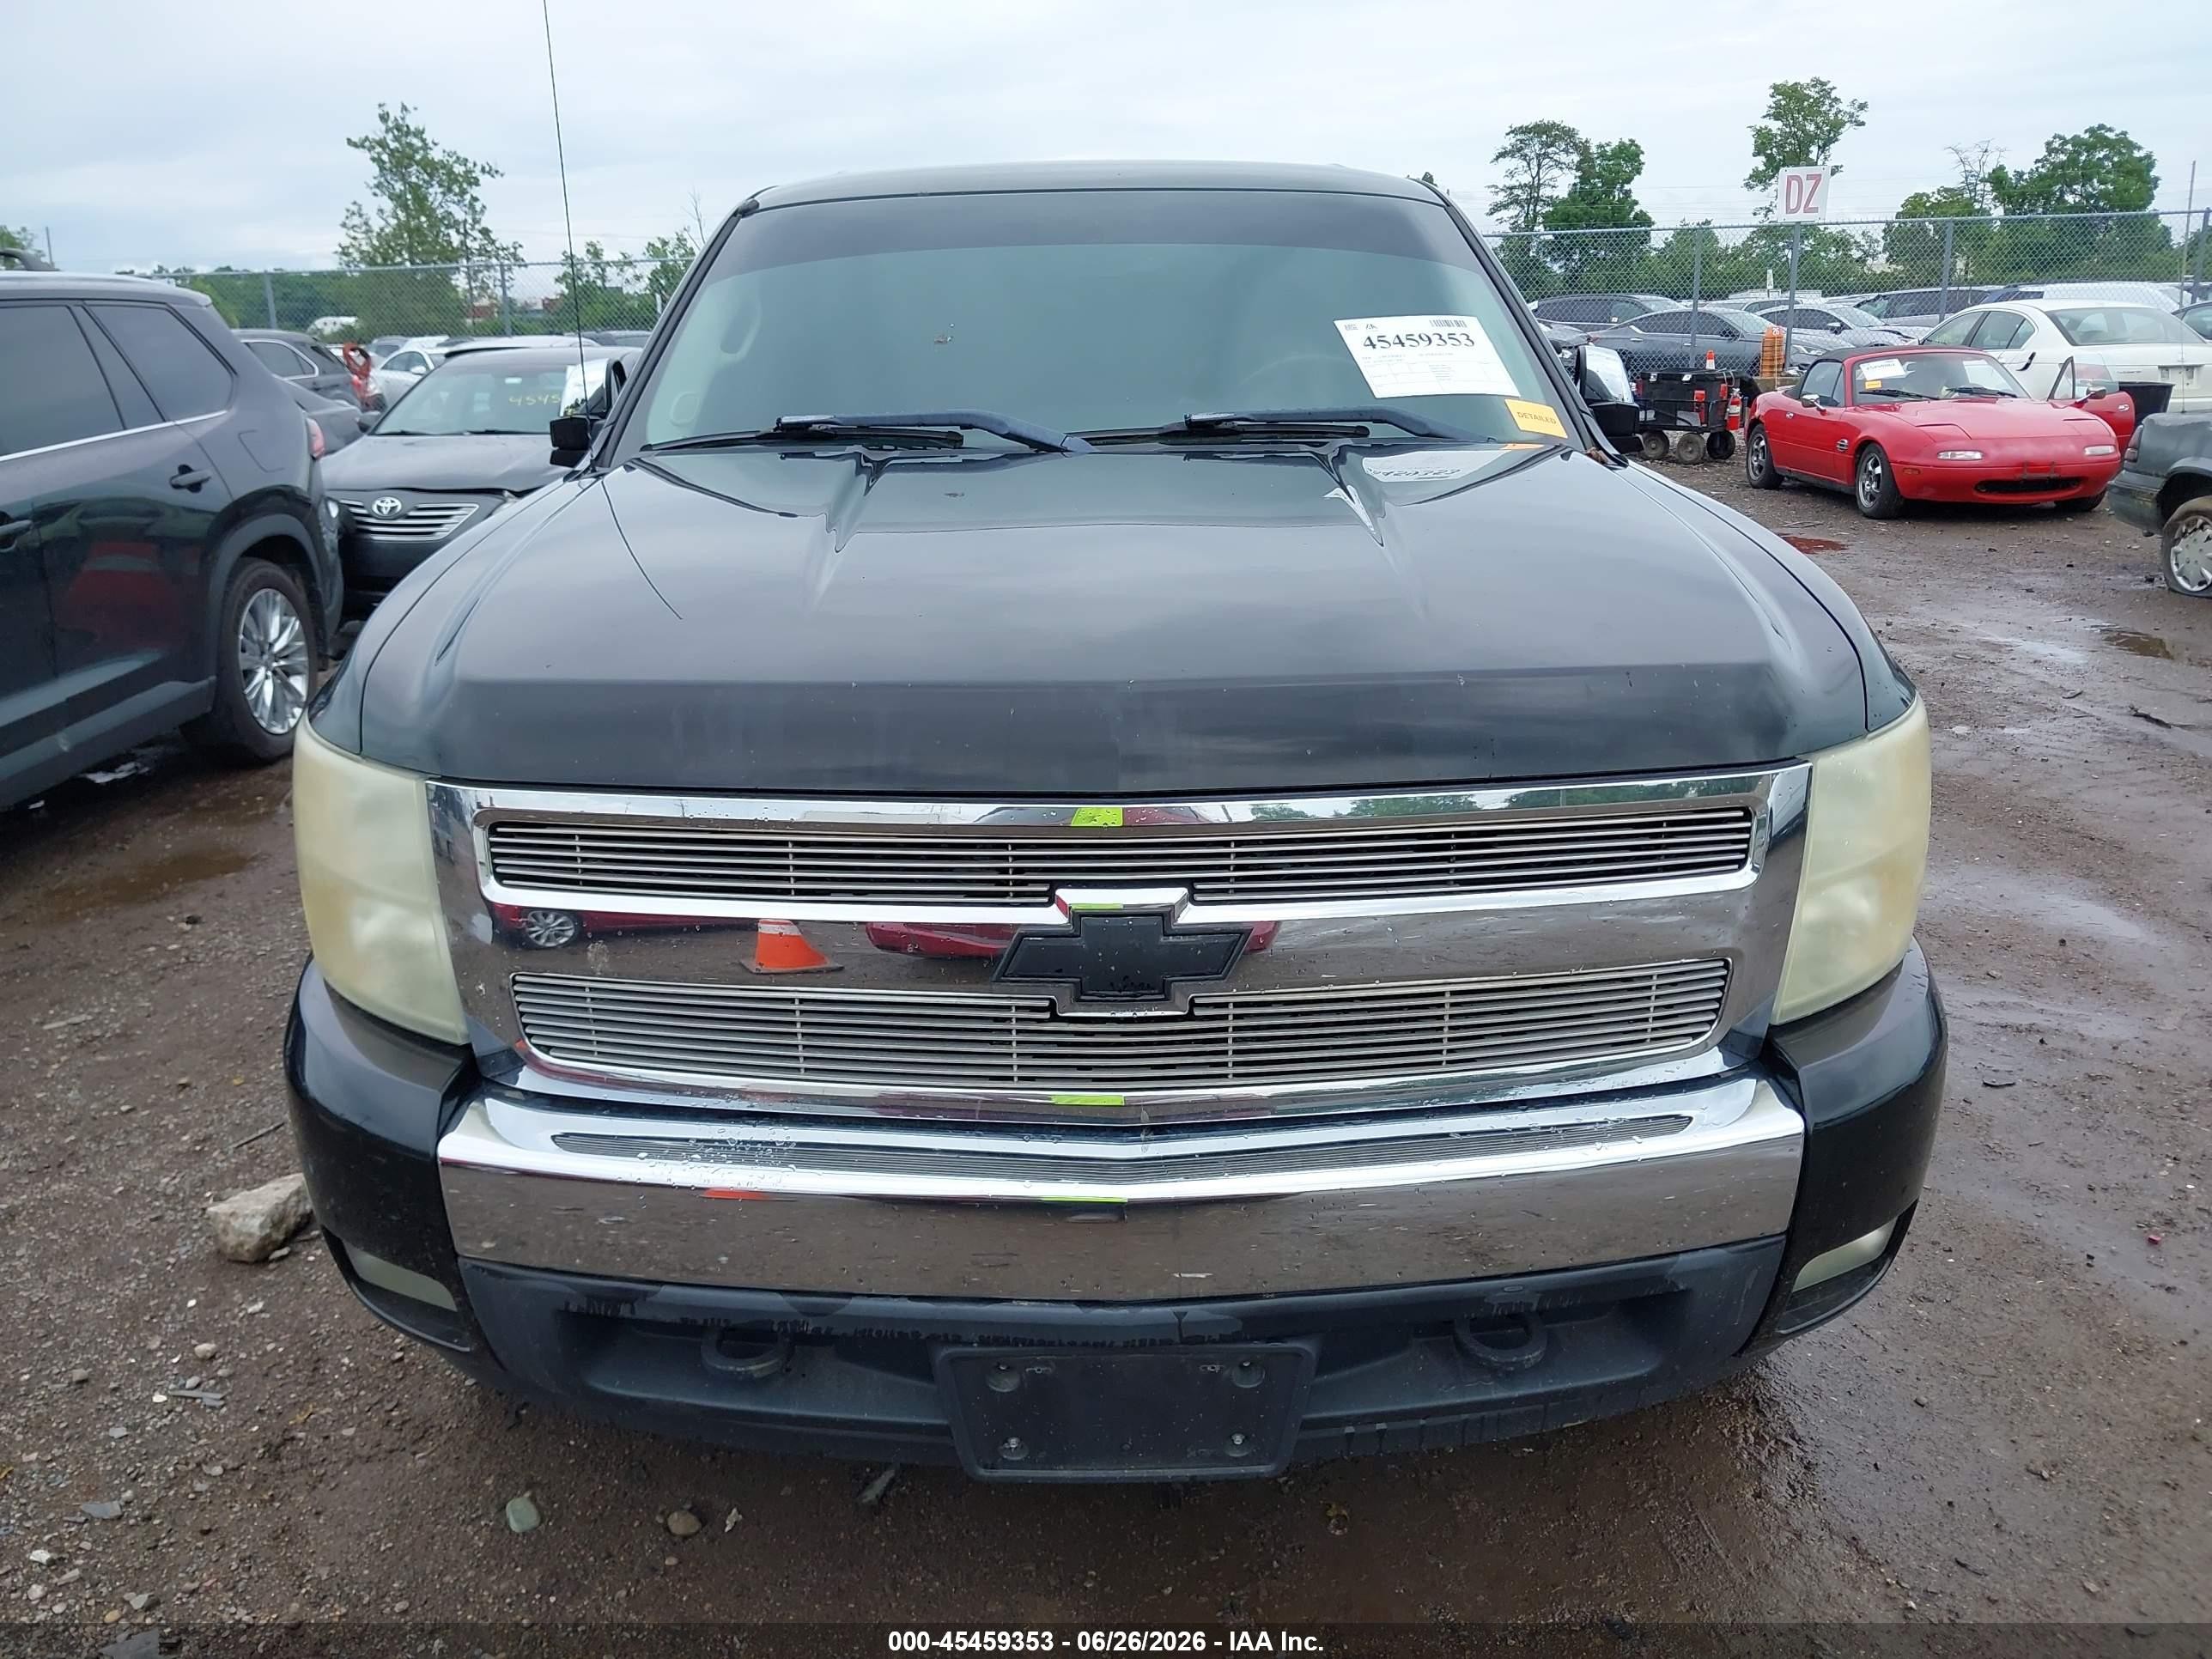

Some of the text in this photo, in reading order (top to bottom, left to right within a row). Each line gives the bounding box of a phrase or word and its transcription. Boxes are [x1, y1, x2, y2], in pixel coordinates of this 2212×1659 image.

[1786, 173, 1822, 215] DZ
[1363, 332, 1475, 349] 45459353
[1516, 411, 1557, 425] DETAILED
